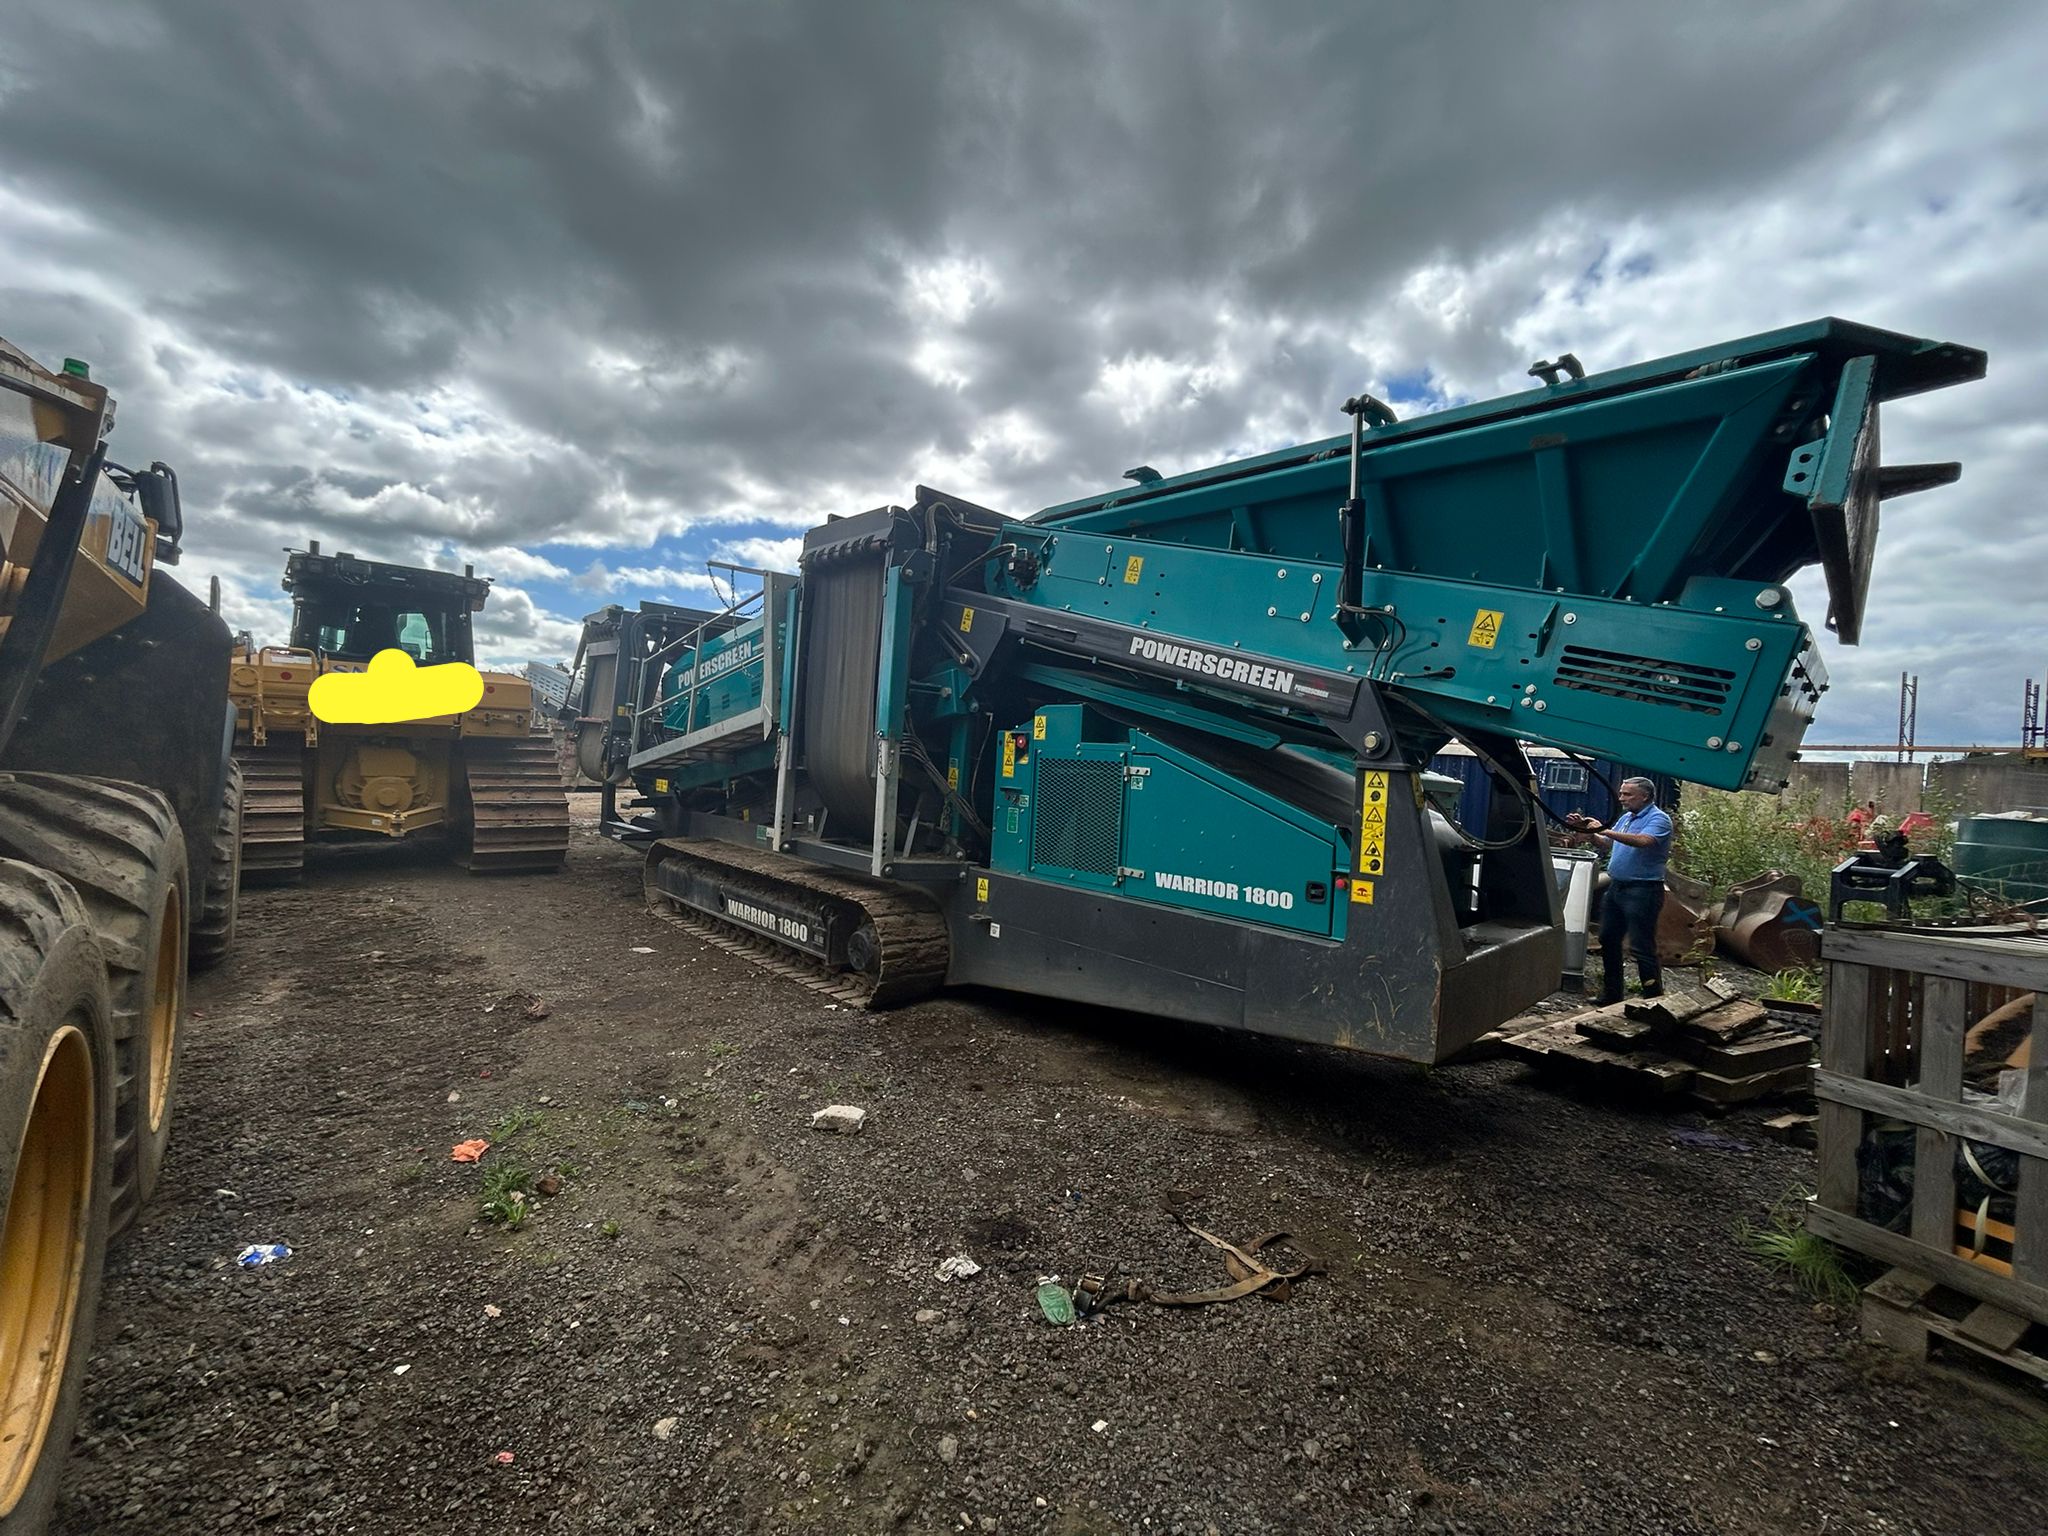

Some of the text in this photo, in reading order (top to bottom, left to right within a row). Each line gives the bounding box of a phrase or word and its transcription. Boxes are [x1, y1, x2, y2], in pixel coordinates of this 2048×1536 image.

[107, 502, 146, 582] BELL
[1130, 636, 1294, 694] POWERSCREEN
[1155, 872, 1293, 910] WARRIOR 1800
[728, 899, 808, 943] WARRIOR 1800
